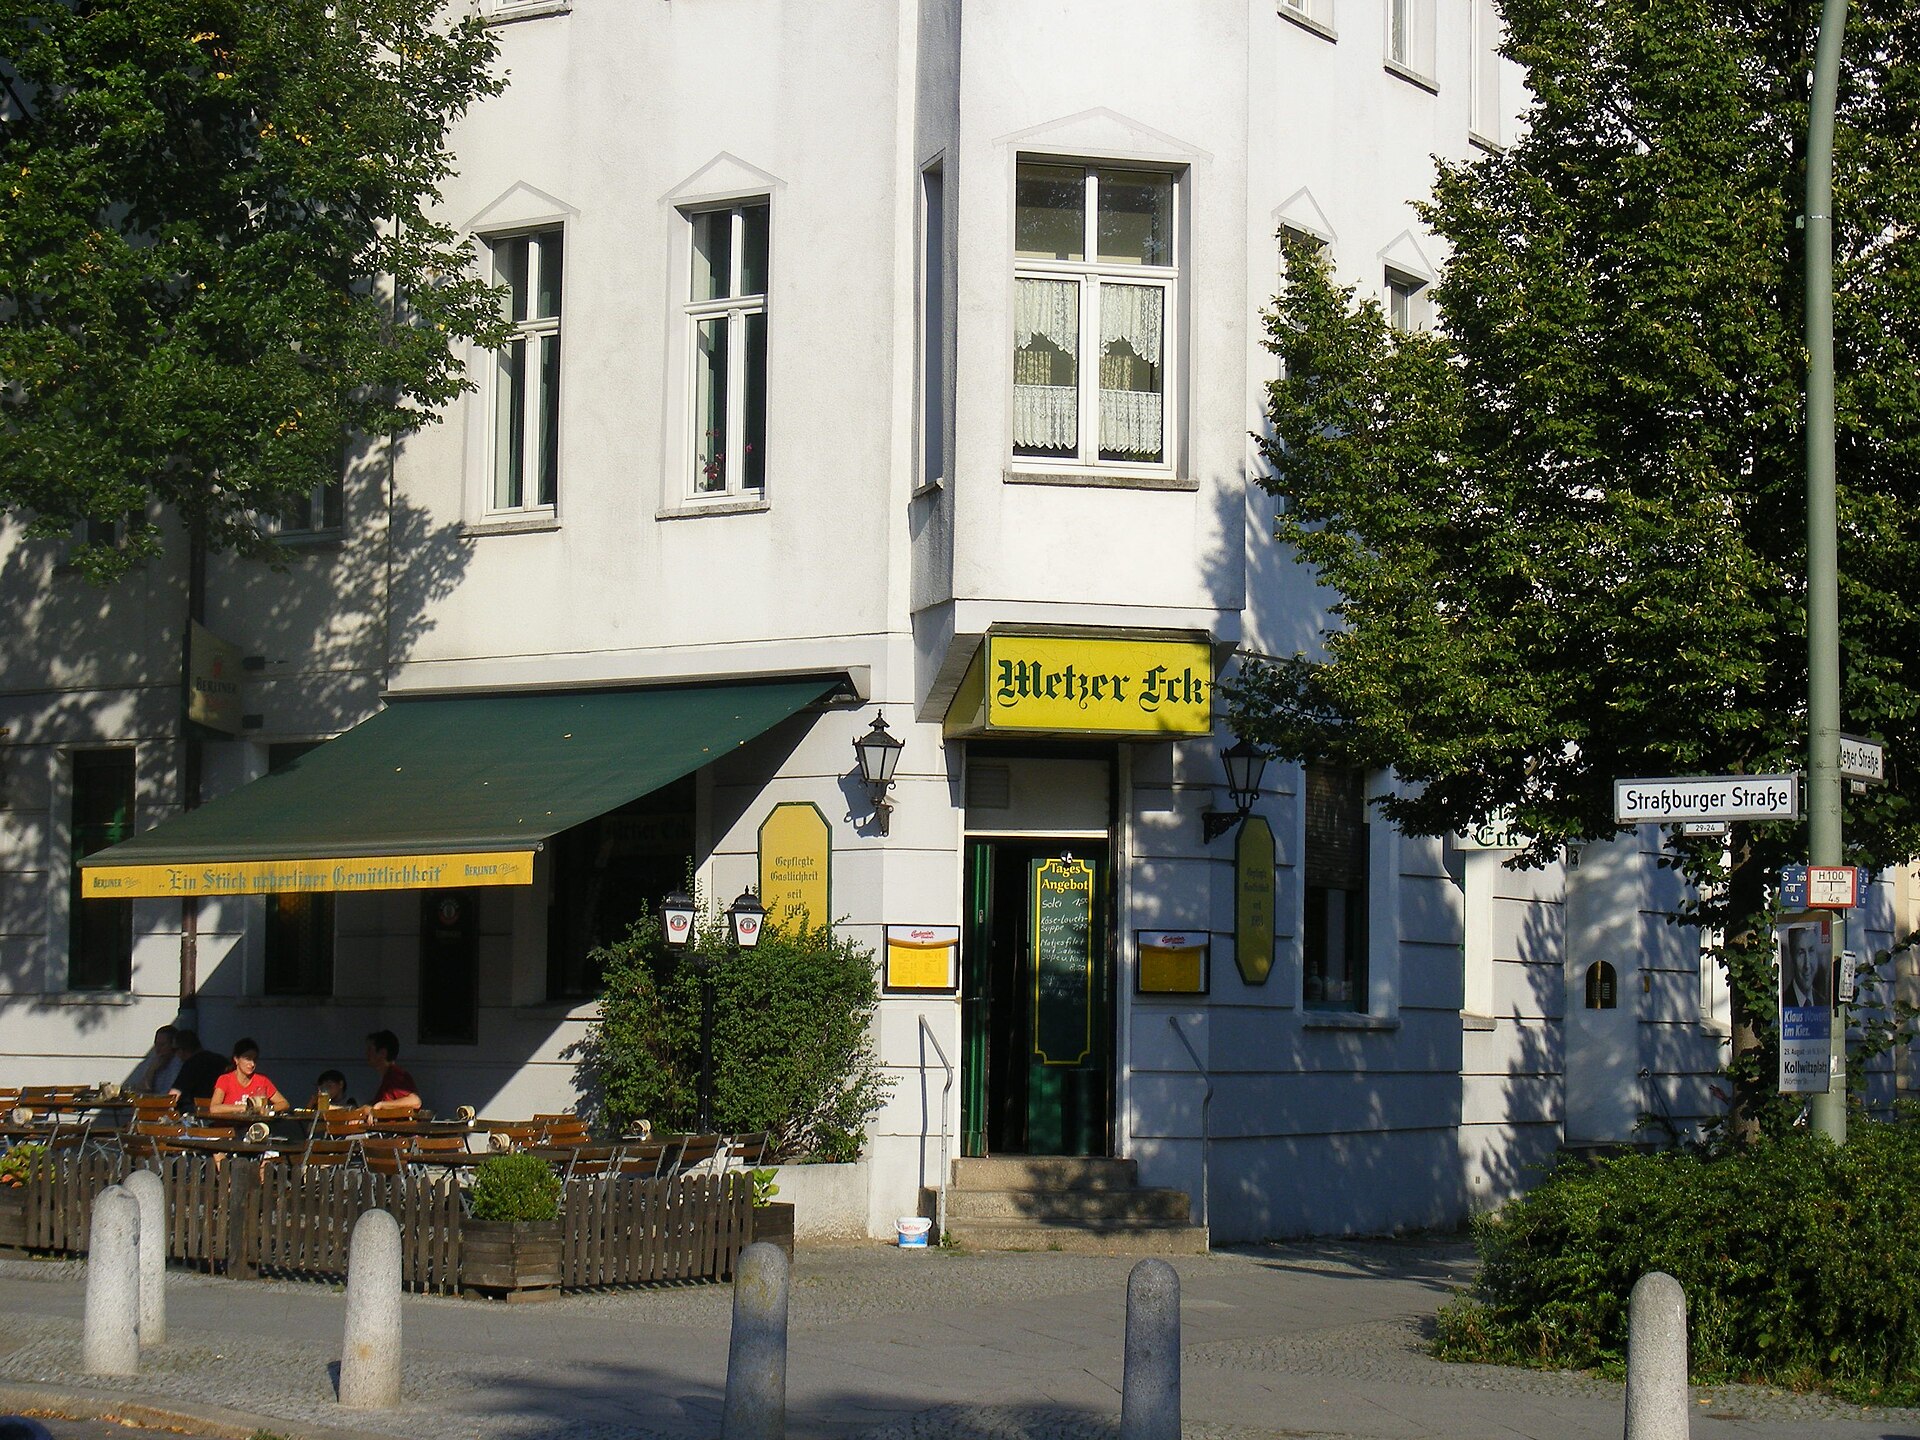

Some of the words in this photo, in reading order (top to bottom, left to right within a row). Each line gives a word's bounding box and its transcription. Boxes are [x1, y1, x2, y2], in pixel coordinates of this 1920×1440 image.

[997, 659, 1130, 710] Metzer
[1139, 664, 1206, 712] Eck
[1858, 747, 1879, 775] Straße
[1627, 789, 1726, 814] Straßburger
[1732, 786, 1788, 812] Straße
[1695, 822, 1715, 832] 29-24
[464, 863, 498, 876] BERLINER
[1050, 862, 1081, 878] Tages
[1782, 871, 1790, 881] S
[93, 876, 122, 889] BERLINER
[203, 868, 247, 889] Stück
[770, 870, 818, 883] Gastlichkeit
[1041, 878, 1089, 894] Angebot
[787, 889, 802, 899] seit
[1784, 1010, 1804, 1023] Klaus
[1784, 1025, 1795, 1037] im
[1784, 1061, 1827, 1076] Kollwitzplatz
